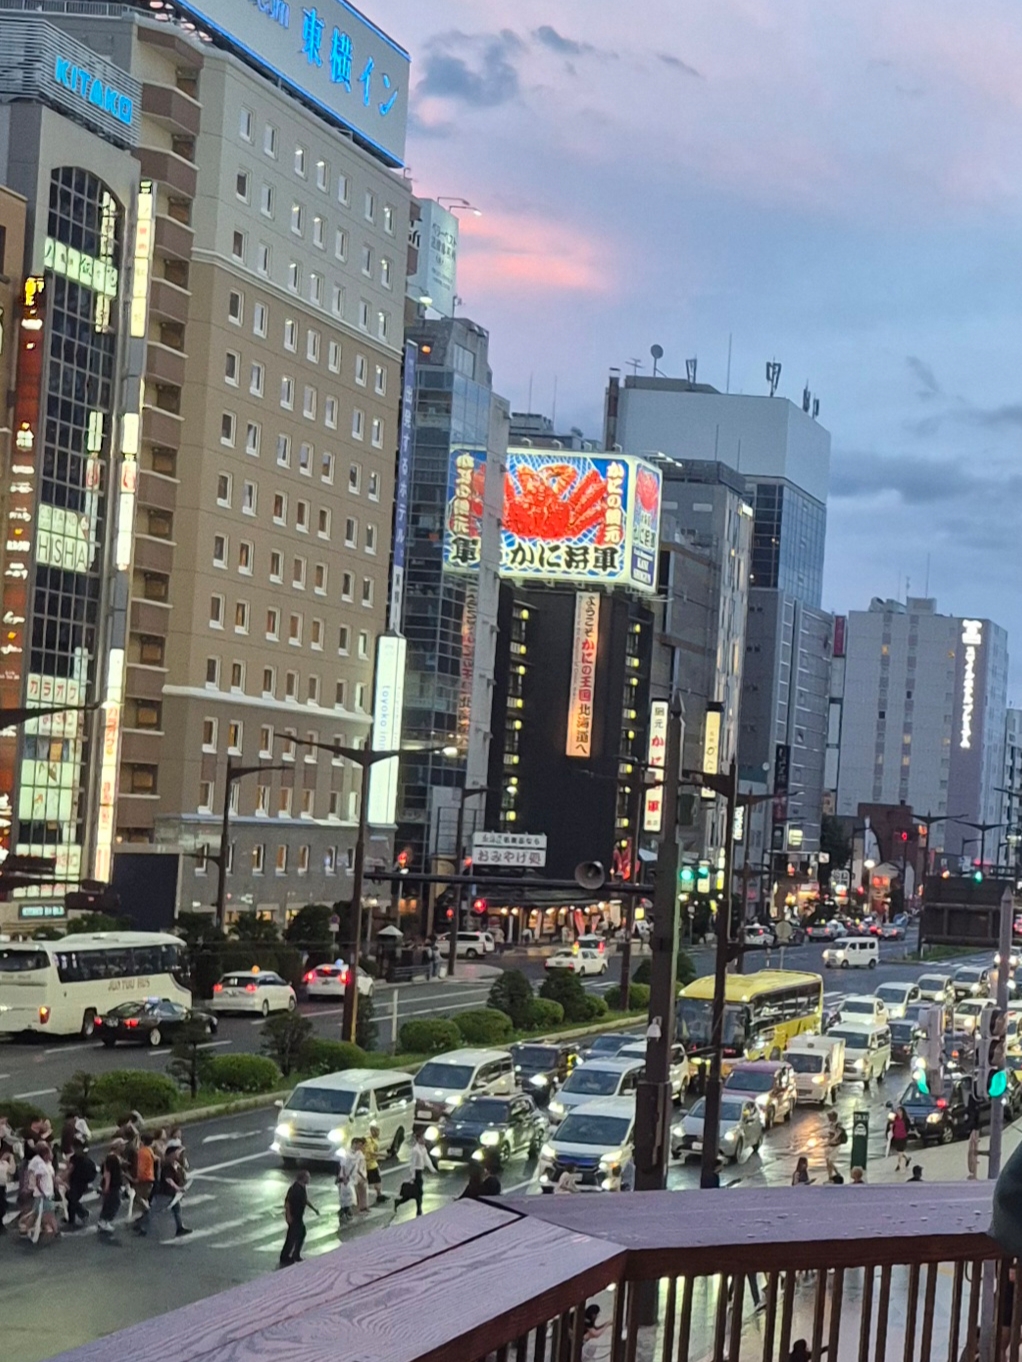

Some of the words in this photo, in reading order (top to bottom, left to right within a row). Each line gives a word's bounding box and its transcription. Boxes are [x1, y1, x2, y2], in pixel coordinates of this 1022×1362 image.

[301, 7, 398, 117] 東横イン
[510, 541, 620, 572] かに将軍
